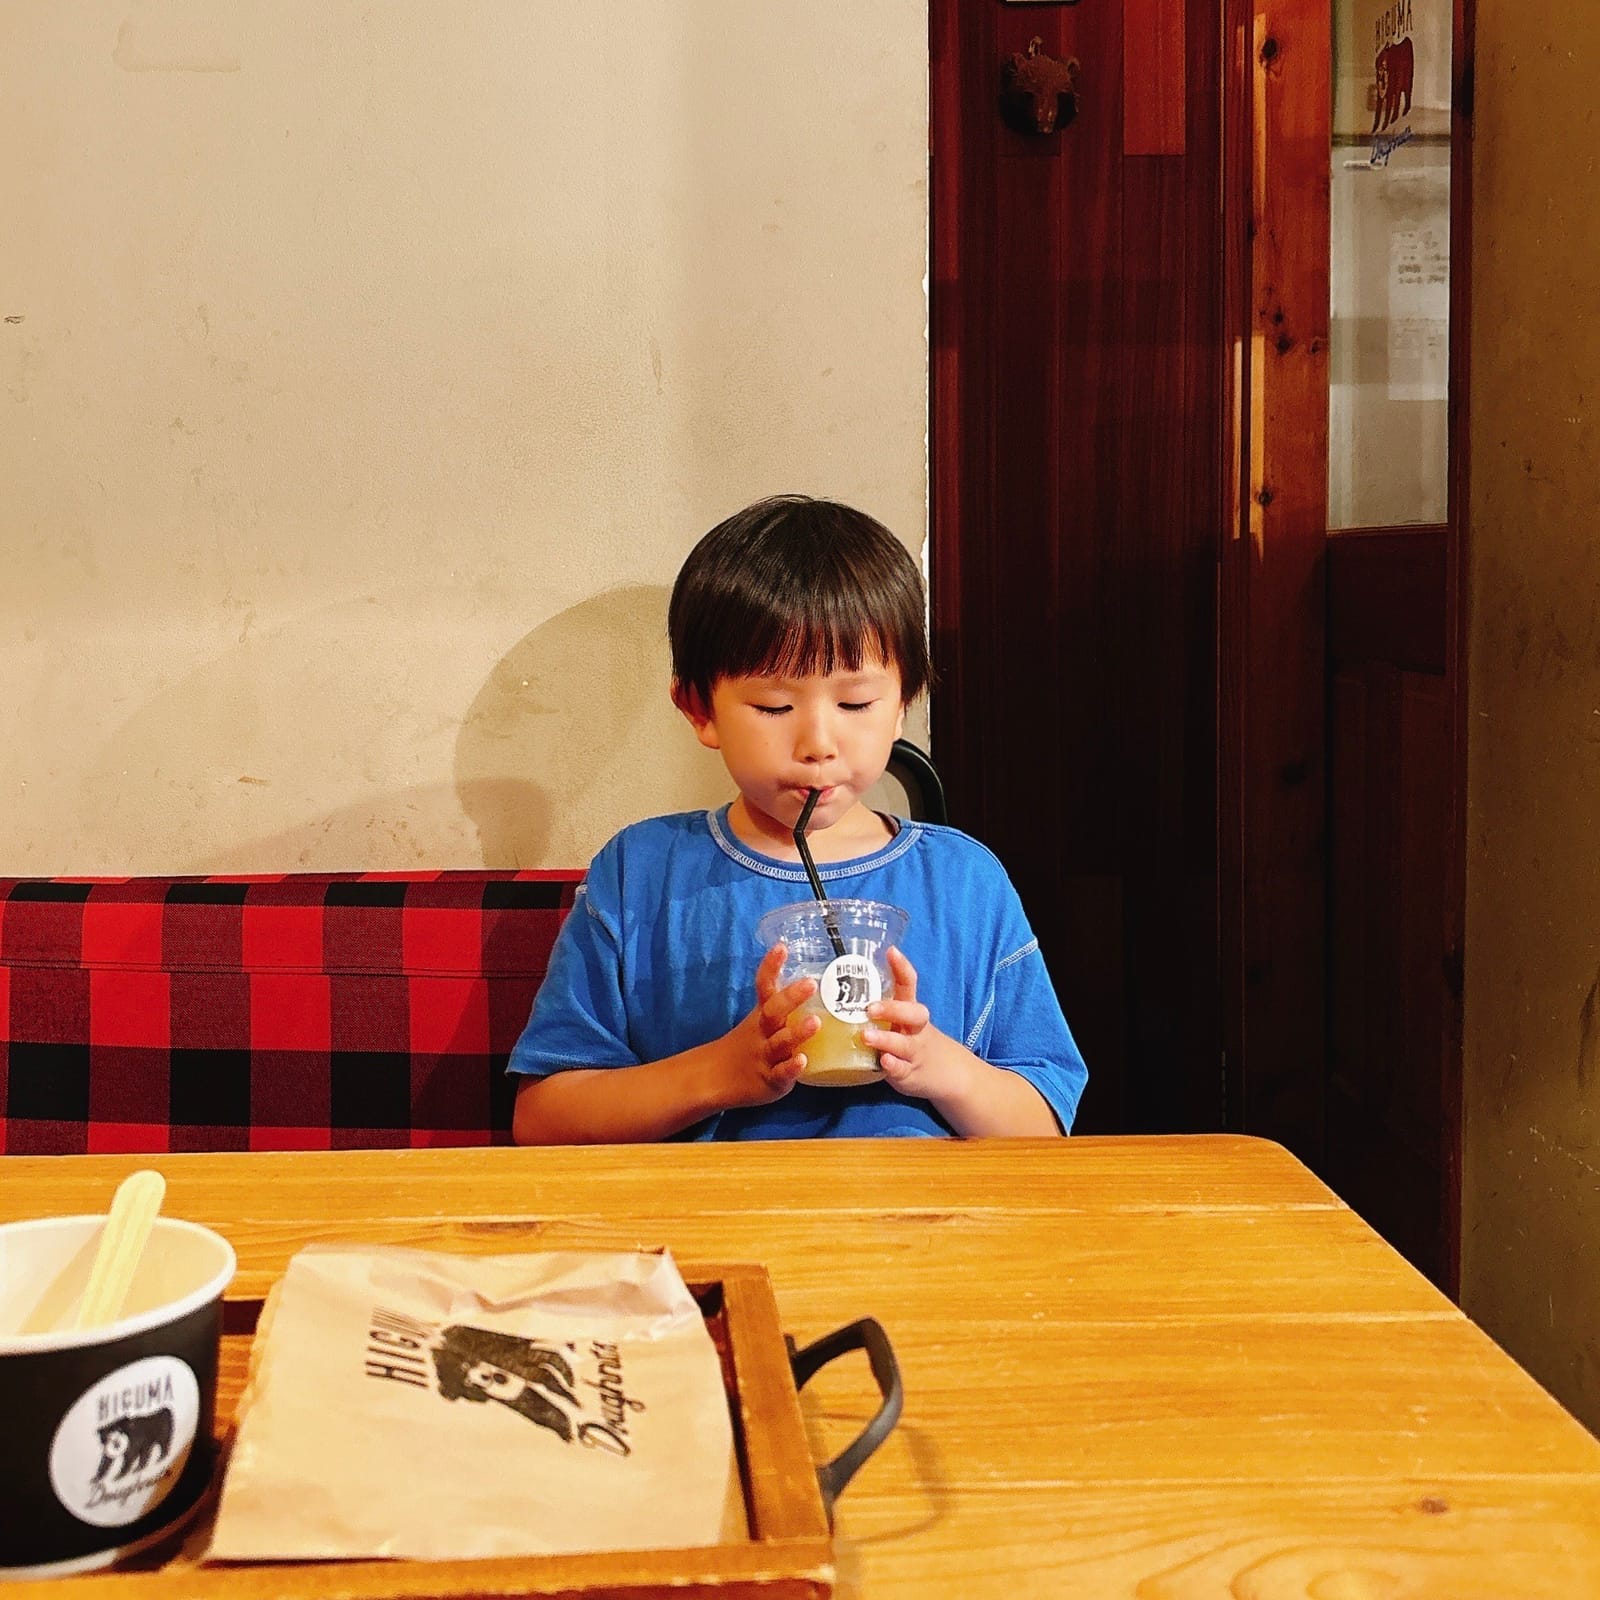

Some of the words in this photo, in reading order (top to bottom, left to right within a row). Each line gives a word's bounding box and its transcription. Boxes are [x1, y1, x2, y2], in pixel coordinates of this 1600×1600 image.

[1376, 0, 1413, 53] HIGUMA
[836, 964, 869, 976] HIGUMA
[98, 1373, 174, 1421] HIGUMA
